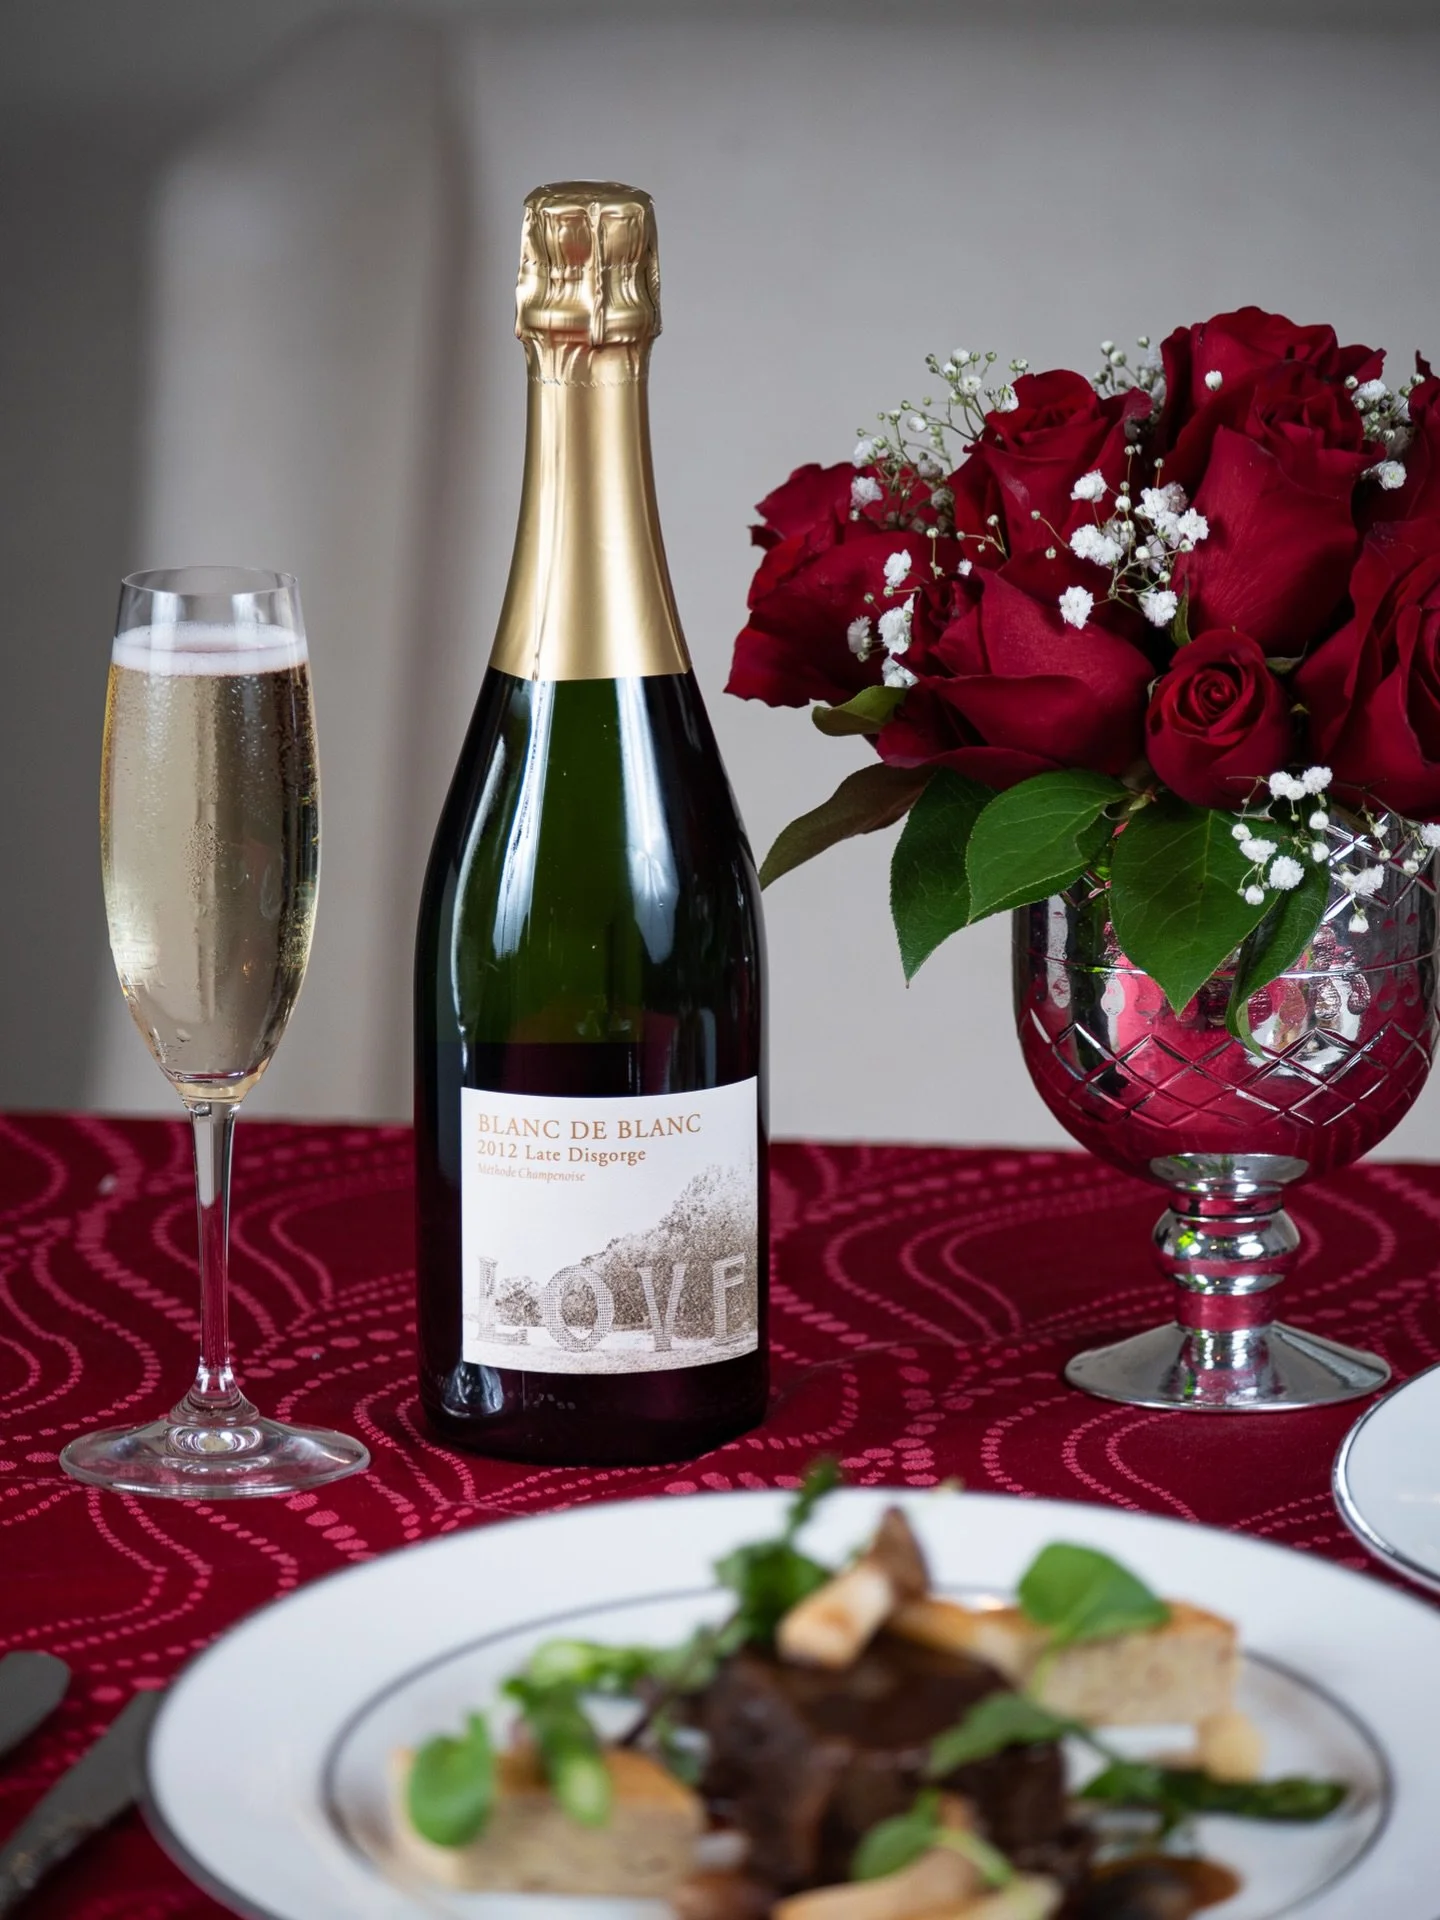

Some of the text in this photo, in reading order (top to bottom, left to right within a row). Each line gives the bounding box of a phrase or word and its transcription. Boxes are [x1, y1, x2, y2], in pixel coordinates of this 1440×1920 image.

[478, 1113, 702, 1140] BLANC DE BLANC
[477, 1140, 647, 1167] 2012 Late Disgorge
[517, 1167, 586, 1184] Champenoise
